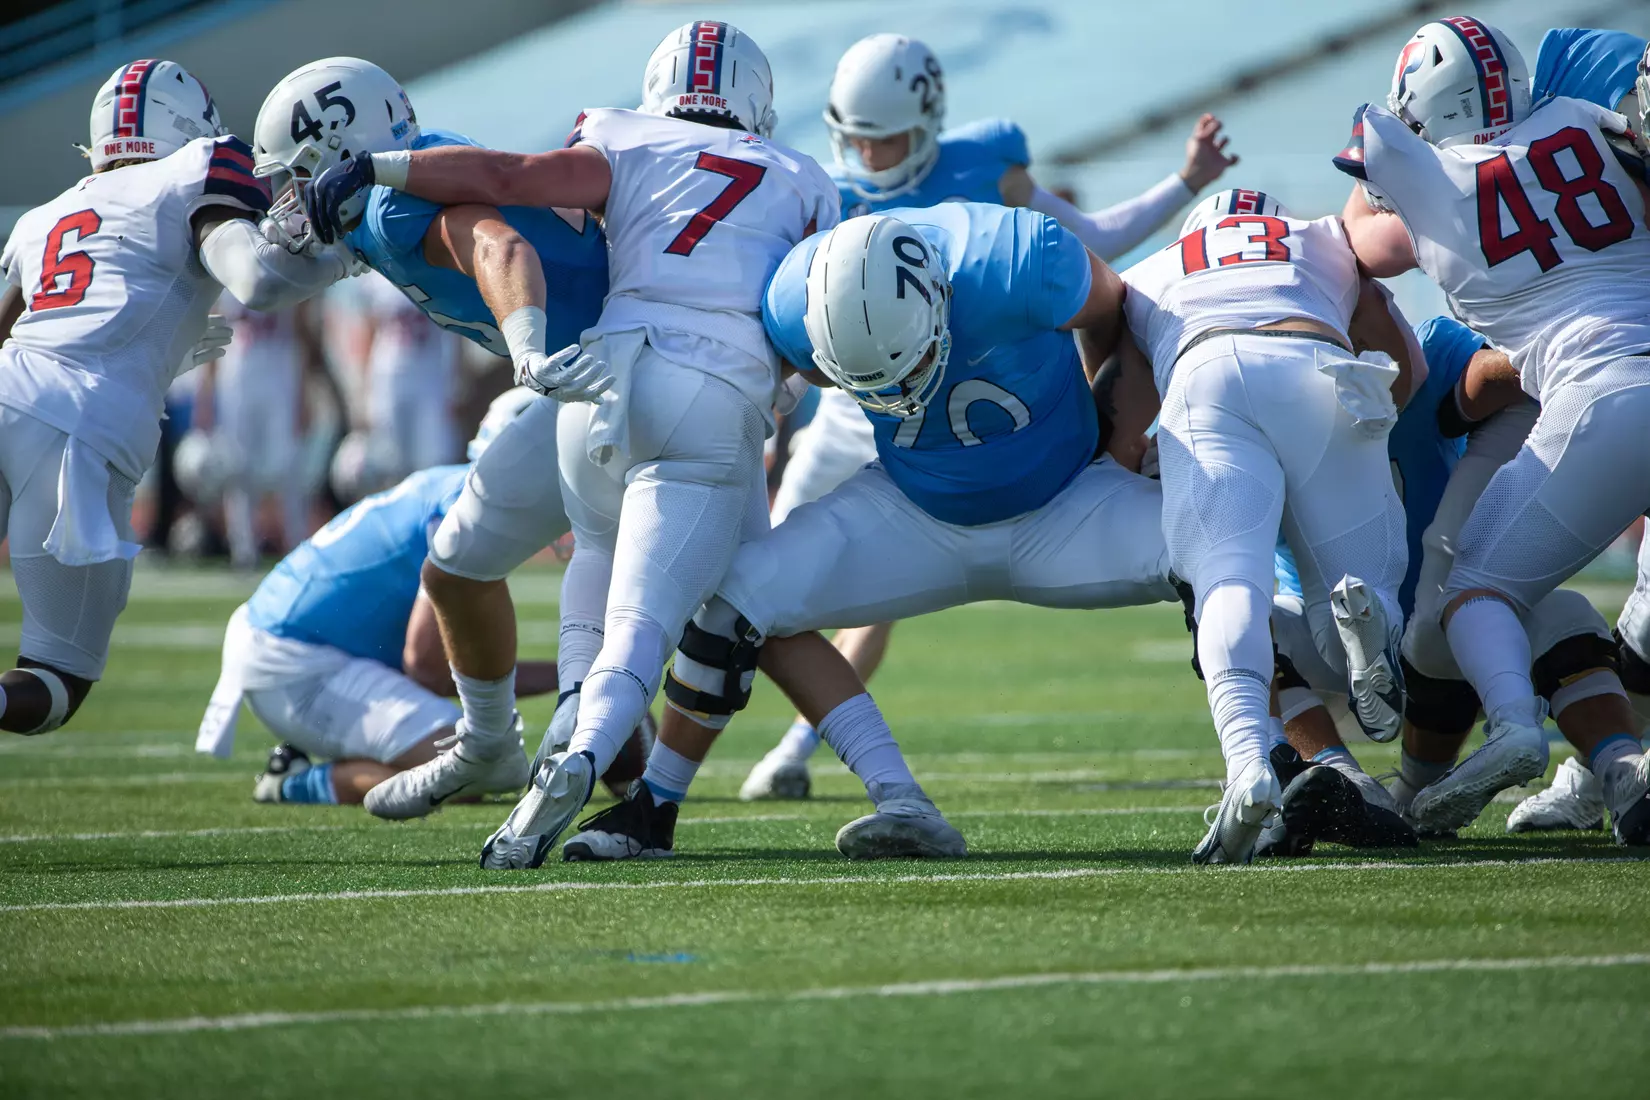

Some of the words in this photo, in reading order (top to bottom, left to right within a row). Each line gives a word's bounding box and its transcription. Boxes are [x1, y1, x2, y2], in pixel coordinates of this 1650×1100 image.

[290, 81, 356, 144] 45
[679, 95, 698, 106] ONE
[701, 95, 728, 109] MORE
[104, 142, 122, 156] ONE
[126, 141, 155, 154] MORE
[1474, 132, 1496, 145] ONE
[663, 151, 767, 257] 7
[1474, 125, 1635, 273] 48
[30, 208, 102, 313] 6
[892, 235, 933, 307] 70
[1165, 215, 1291, 275] 13
[850, 370, 885, 382] LIONS
[864, 378, 1032, 449] 70
